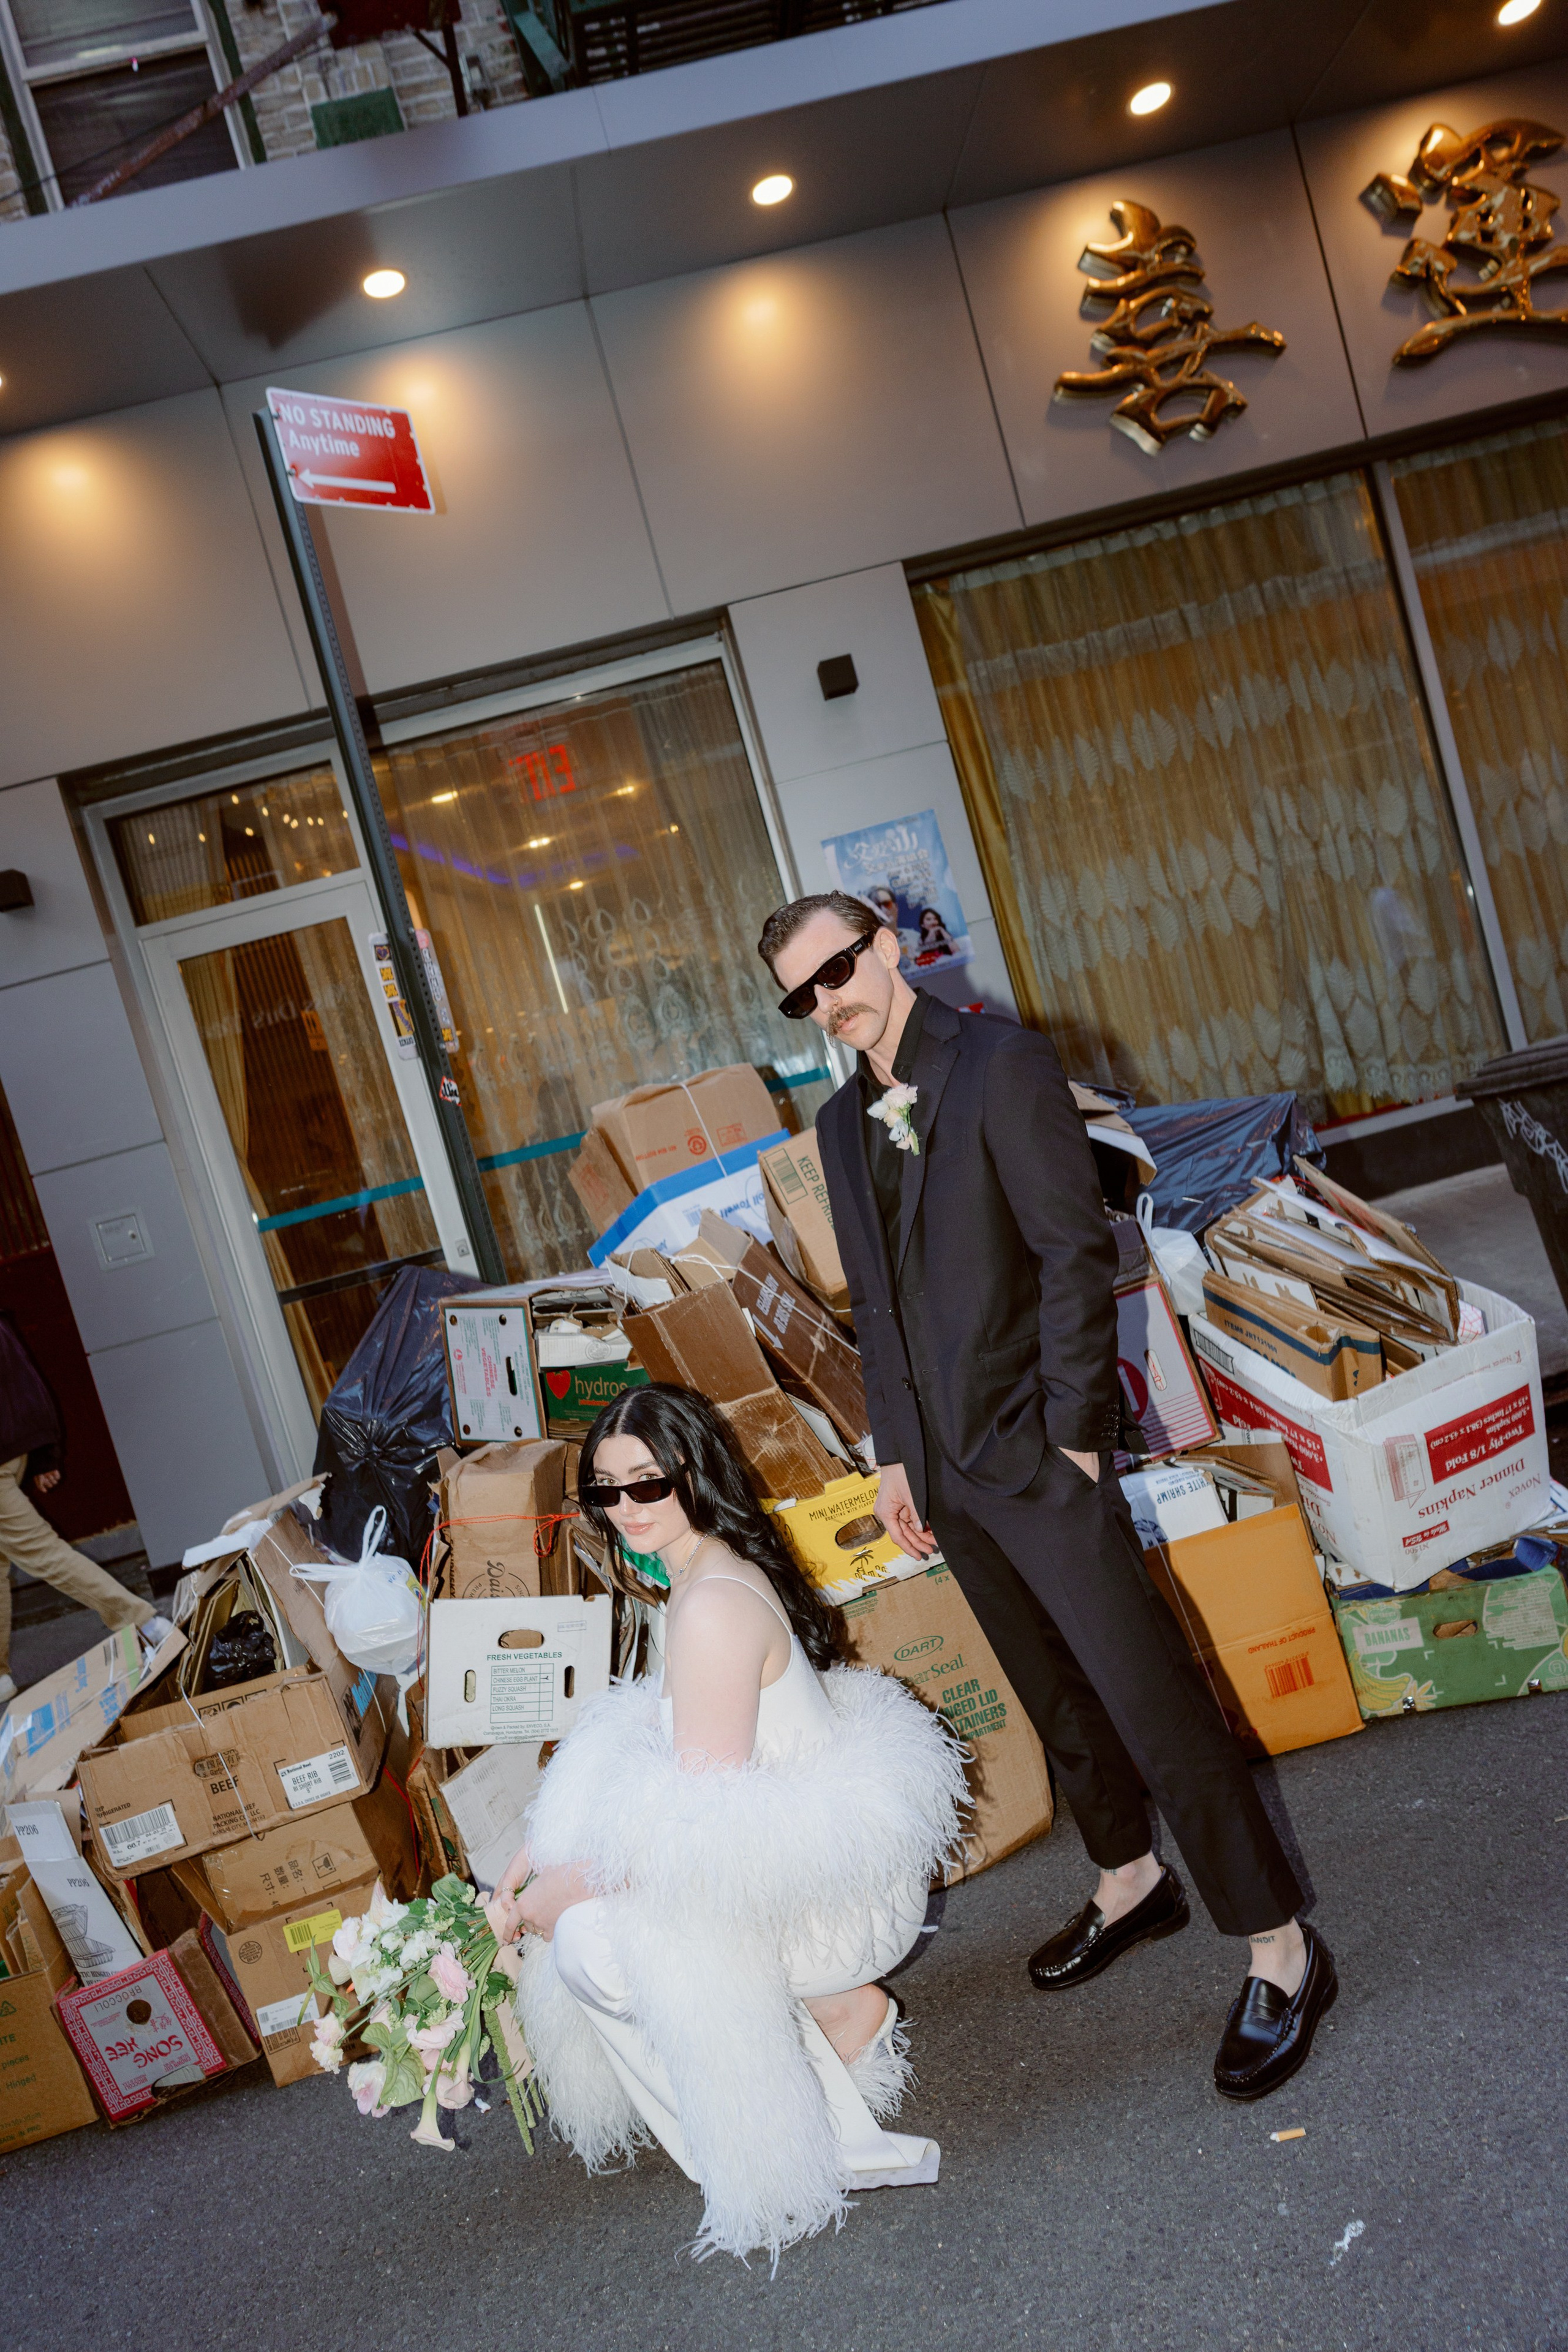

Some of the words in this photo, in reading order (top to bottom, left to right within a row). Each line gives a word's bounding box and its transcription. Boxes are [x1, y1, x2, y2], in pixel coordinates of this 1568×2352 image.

[279, 403, 306, 426] NO
[310, 409, 396, 439] STANDING
[289, 429, 360, 457] Anytime
[797, 1155, 820, 1182] KEEP
[774, 1317, 786, 1334] UP
[481, 1348, 491, 1397] VEGETABLES
[1483, 1407, 1505, 1425] Inches
[1486, 1416, 1512, 1435] Napkins
[1430, 1438, 1444, 1450] cm)
[1489, 1424, 1525, 1450] Two-Ply
[1470, 1444, 1487, 1459] 1/8
[1445, 1452, 1469, 1472] Fold
[1479, 1458, 1526, 1490] Dinner
[1156, 1485, 1186, 1506] SHRIMP
[1509, 1473, 1542, 1500] Novex
[809, 1509, 827, 1521] MINI
[827, 1488, 879, 1515] WATERMELON
[859, 1499, 875, 1509] FLAVOR
[1418, 1483, 1477, 1519] Napkins
[1405, 1542, 1430, 1555] N1500
[1278, 1637, 1287, 1646] OF
[1288, 1627, 1316, 1642] PRODUCT
[1363, 1627, 1411, 1647] BANANAS
[513, 1651, 562, 1660] VEGETABLES
[901, 1638, 937, 1659] DART
[1248, 1639, 1278, 1654] THAILAND
[942, 1678, 981, 1704] CLEAR
[978, 1689, 998, 1707] LID
[328, 1749, 345, 1760] 2202
[287, 1765, 303, 1774] National
[292, 1773, 306, 1785] BEEF
[307, 1770, 318, 1780] RIB
[210, 1775, 239, 1795] BEEF
[299, 1781, 313, 1790] SHORT
[212, 1809, 243, 1822] NATIONAL
[213, 1817, 238, 1829] PACKING
[250, 1808, 261, 1817] LLC
[15, 1825, 39, 1836] PP206
[67, 1878, 90, 1887] PP206
[259, 1872, 276, 1896] 尺寸:
[94, 1985, 143, 2013] BROCCOLI
[105, 2037, 140, 2062] HEE
[133, 2035, 183, 2069] SONG
[2, 2054, 30, 2071] pieces
[5, 2073, 37, 2090] Hinged
[26, 2125, 42, 2134] PRC
